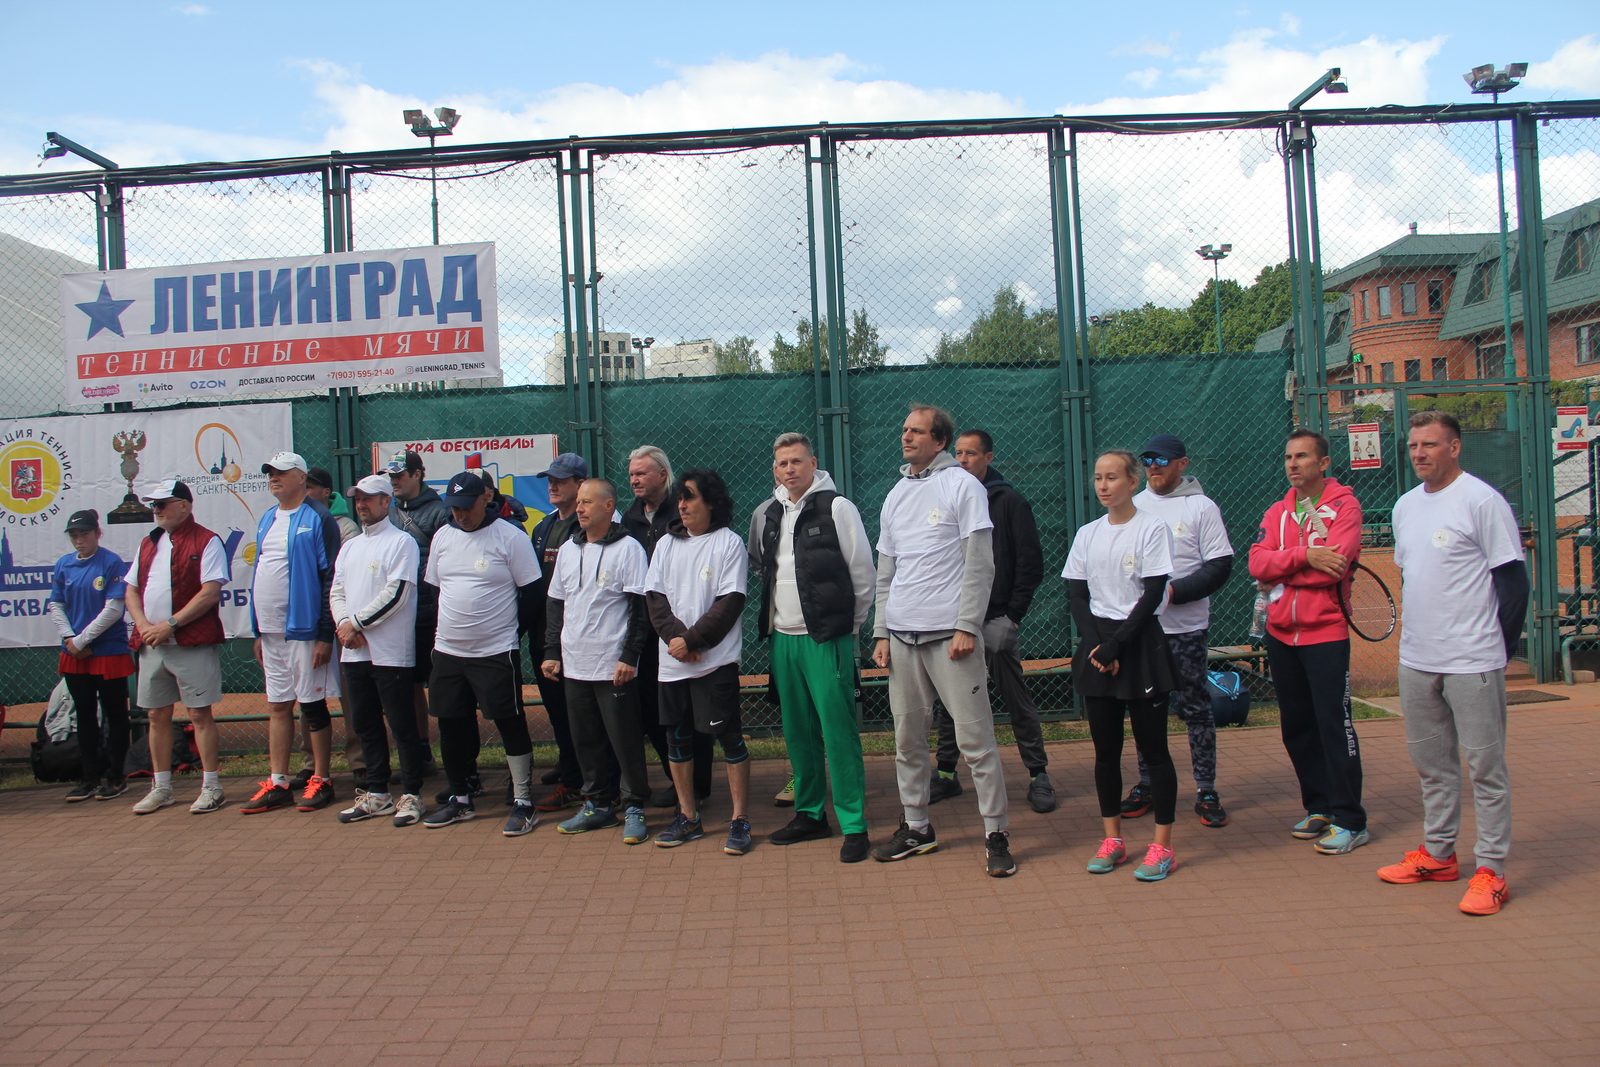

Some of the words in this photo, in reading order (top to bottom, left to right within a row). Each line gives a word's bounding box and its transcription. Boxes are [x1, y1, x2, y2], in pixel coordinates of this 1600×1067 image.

[149, 254, 482, 335] ЛЕНИНГРАД
[326, 371, 356, 380] +7(903)
[357, 368, 395, 378] 595-21-40
[415, 362, 485, 373] @LENINGRAD_TENNIS
[190, 380, 226, 390] OZON
[238, 376, 274, 387] ДОСТАВКА
[275, 375, 285, 384] ПО
[286, 374, 315, 383] РОССИИ
[150, 383, 174, 392] Avito
[40, 431, 73, 491] ТЕННИСА
[4, 572, 43, 585] МАТЧ
[1345, 728, 1357, 757] EAGLE
